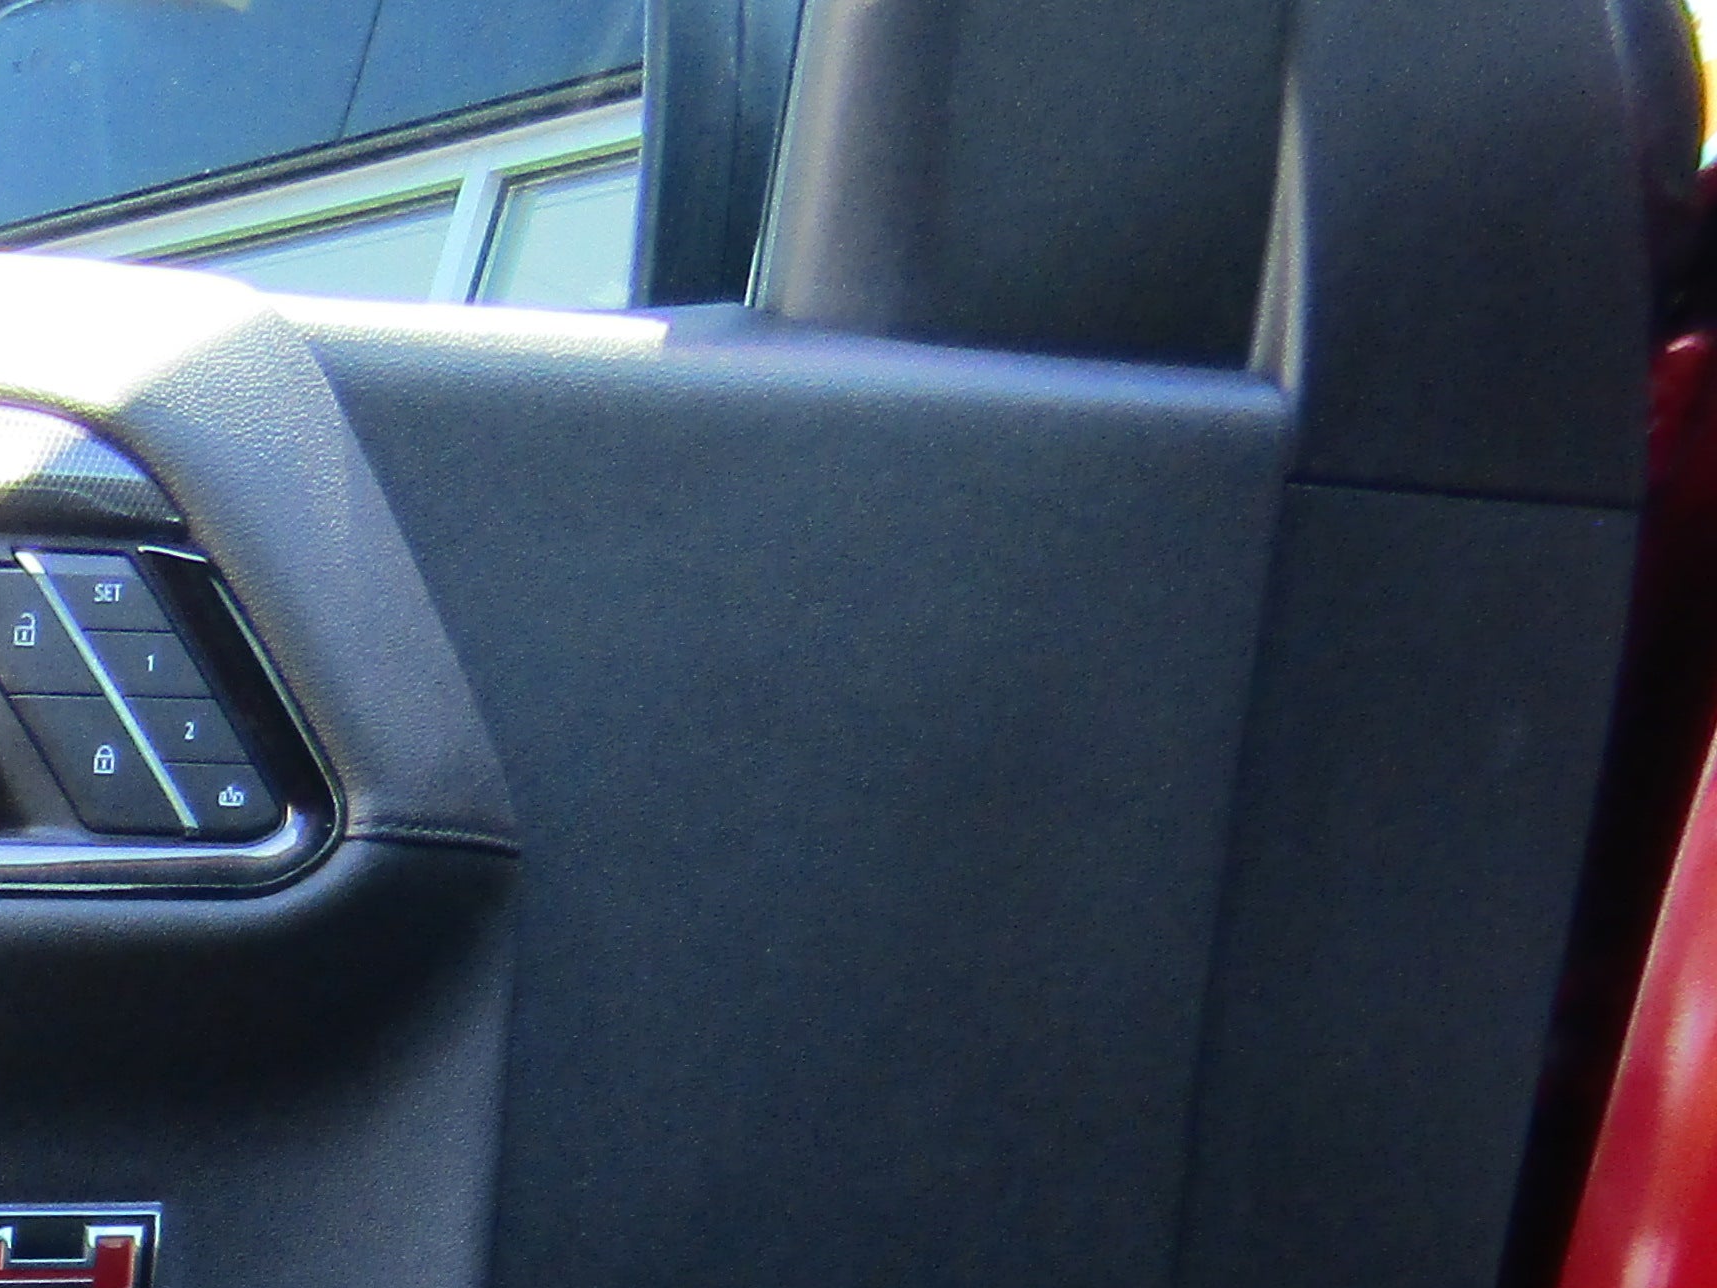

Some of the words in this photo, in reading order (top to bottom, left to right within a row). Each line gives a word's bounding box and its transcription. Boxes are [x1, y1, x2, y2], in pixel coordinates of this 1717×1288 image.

[93, 583, 122, 602] SET
[145, 655, 155, 672] 1
[183, 721, 196, 740] 2
